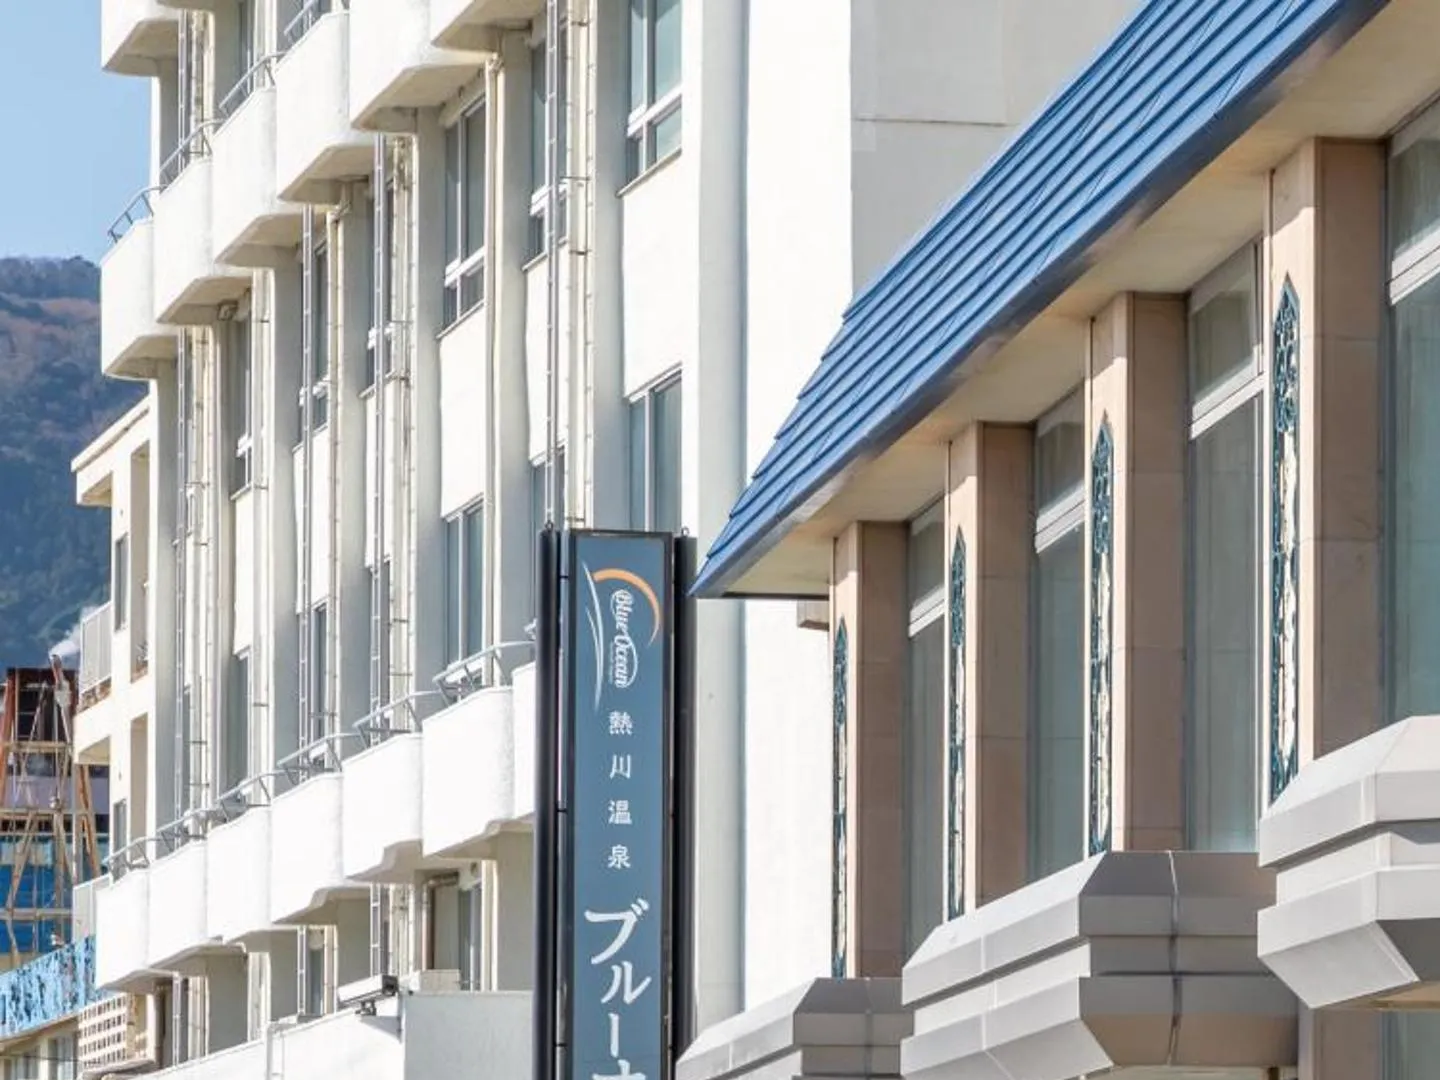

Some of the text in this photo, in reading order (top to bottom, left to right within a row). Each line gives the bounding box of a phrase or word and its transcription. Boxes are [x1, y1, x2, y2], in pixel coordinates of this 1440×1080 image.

[610, 589, 638, 688] Blue Ocean
[607, 710, 634, 869] 熱川温泉
